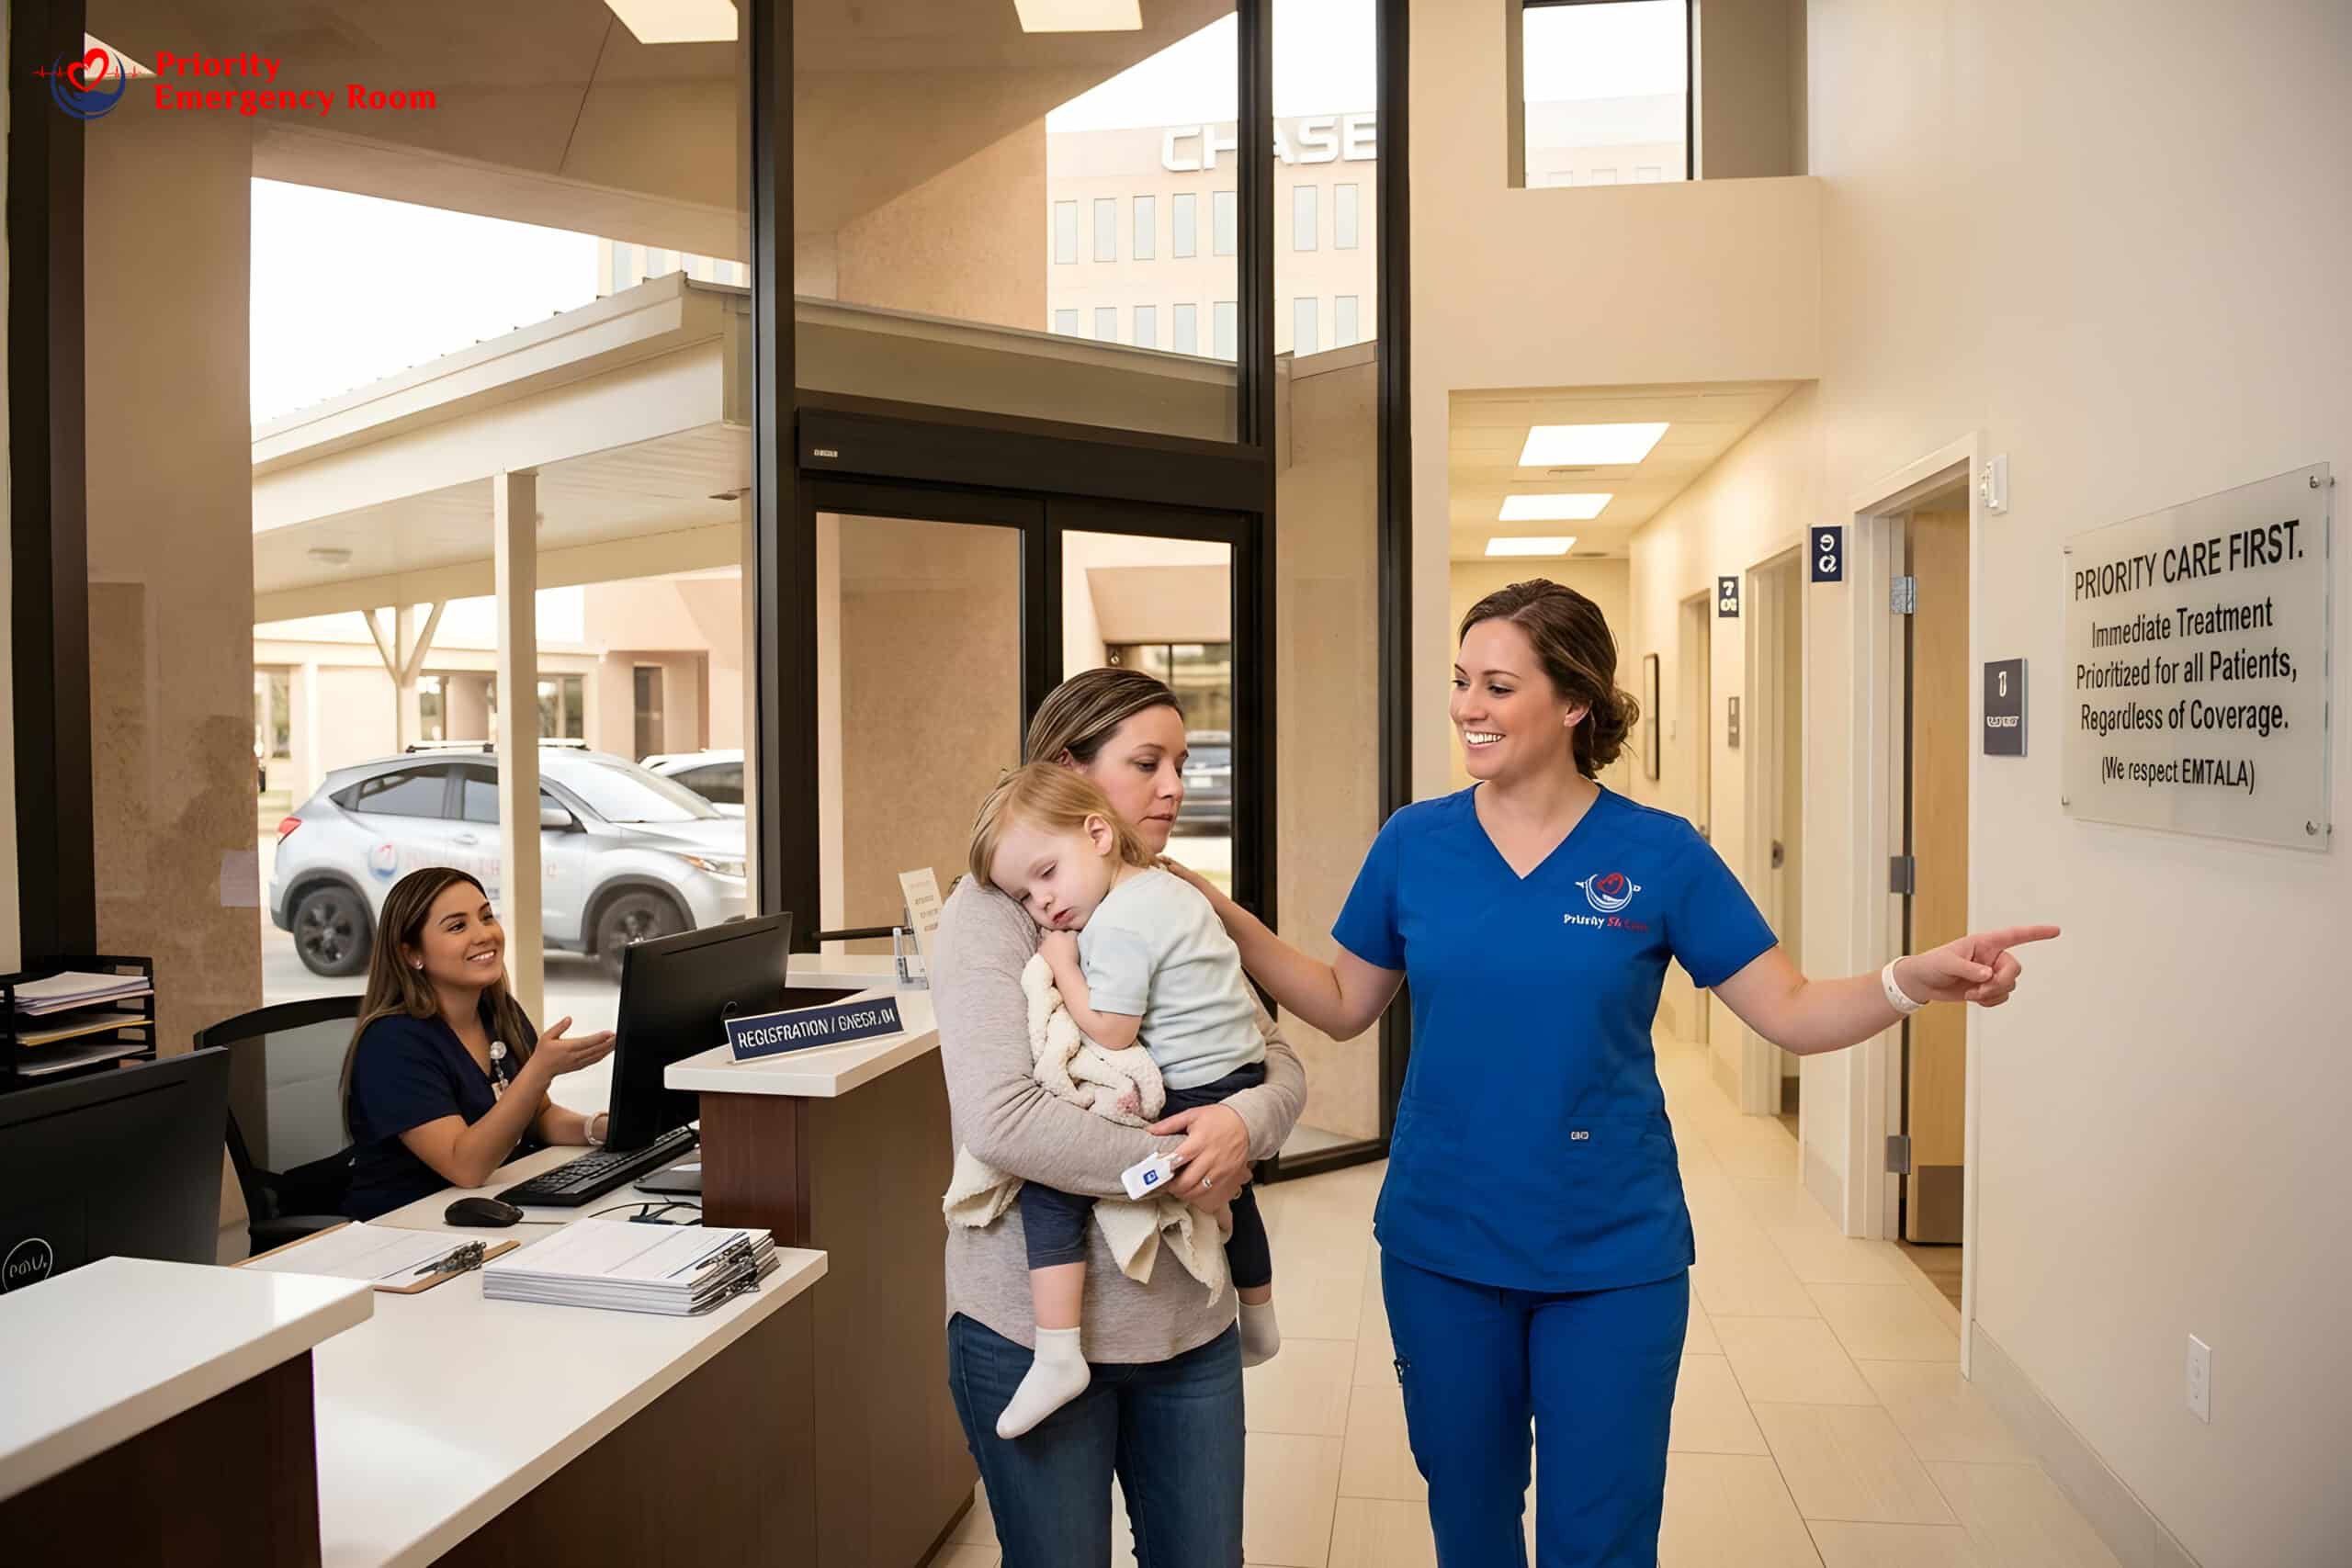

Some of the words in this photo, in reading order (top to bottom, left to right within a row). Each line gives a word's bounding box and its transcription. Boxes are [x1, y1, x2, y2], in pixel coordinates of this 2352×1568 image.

[2075, 552, 2157, 601] PRIORITY
[2163, 537, 2222, 583] CARE
[2230, 519, 2303, 571] FIRST.
[2092, 613, 2171, 648] Immediate
[2177, 595, 2273, 637] Treatment
[2076, 658, 2150, 690] Prioritized
[2155, 656, 2179, 684] for
[2184, 651, 2203, 682] all
[2211, 646, 2297, 683] Patients,
[2081, 701, 2163, 737] Regardless
[2168, 699, 2186, 729] of
[2190, 699, 2289, 737] Coverage.
[2102, 756, 2124, 784] (We
[2129, 761, 2178, 787] respect
[2182, 758, 2255, 795] EMTALA)
